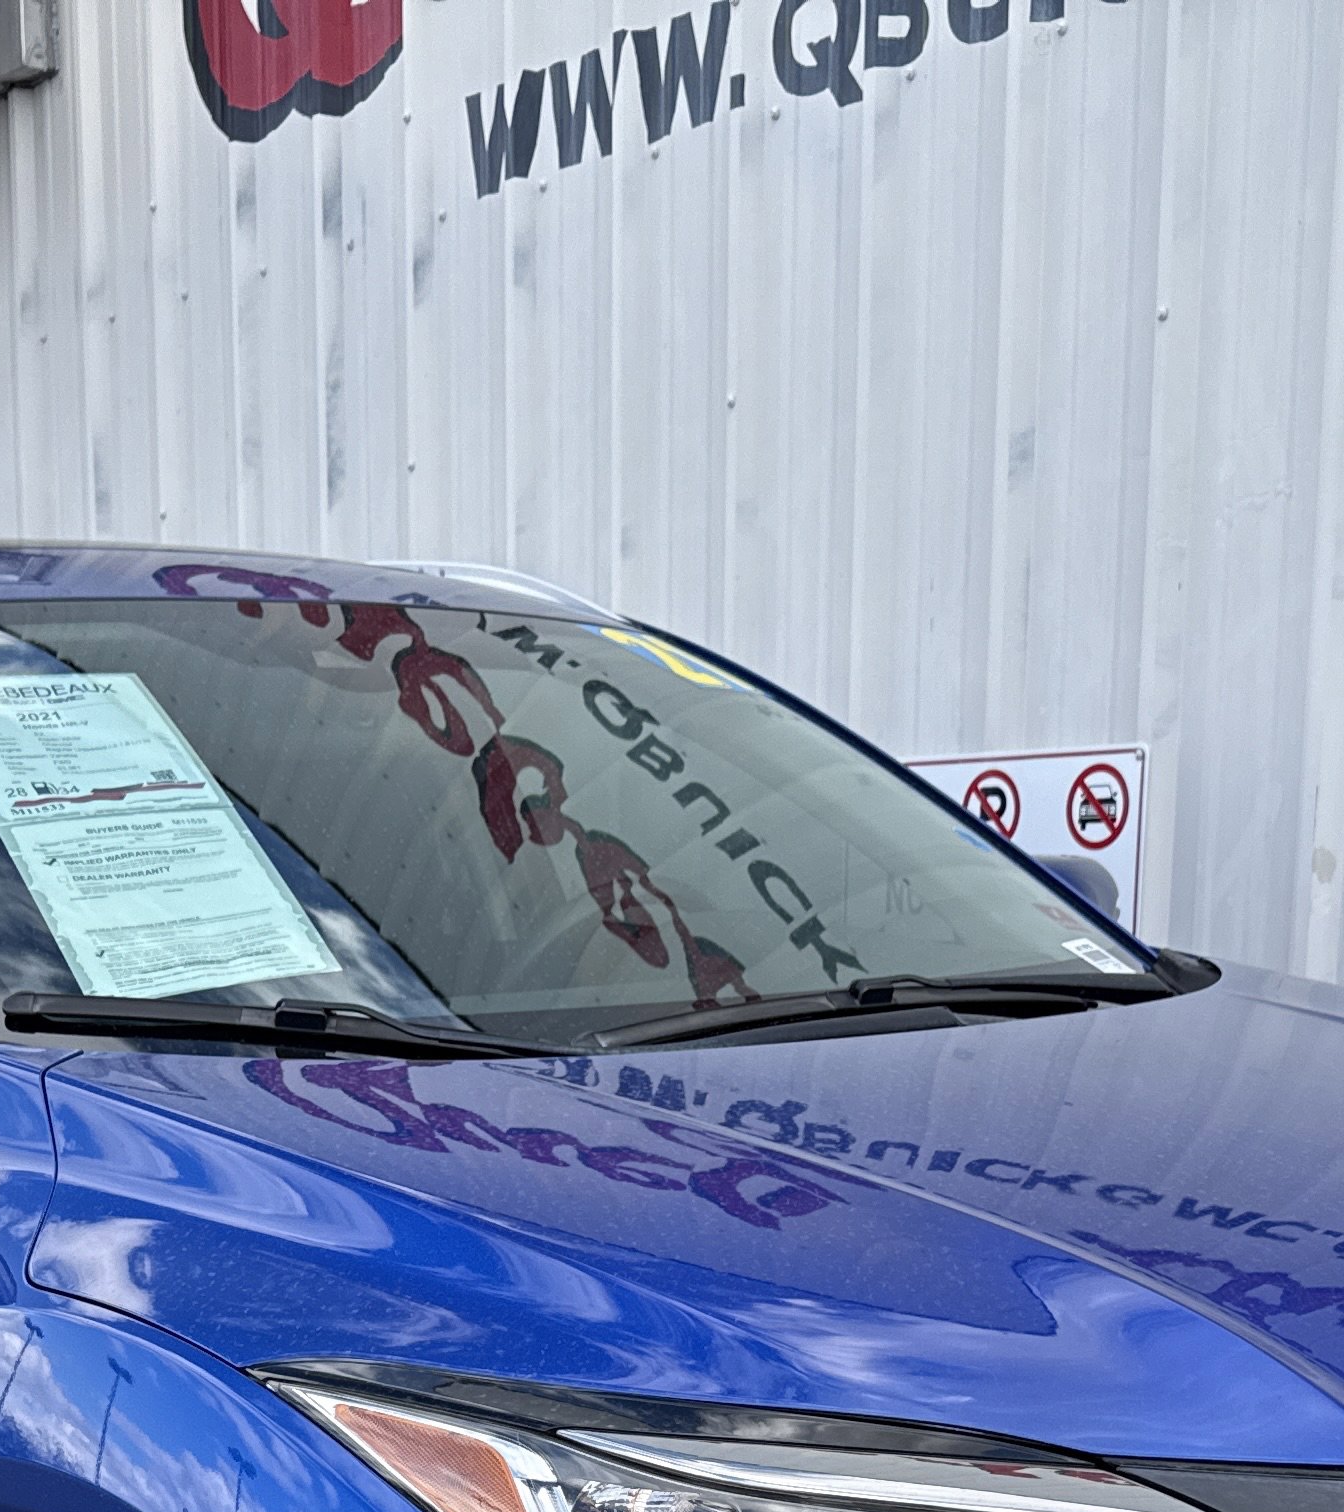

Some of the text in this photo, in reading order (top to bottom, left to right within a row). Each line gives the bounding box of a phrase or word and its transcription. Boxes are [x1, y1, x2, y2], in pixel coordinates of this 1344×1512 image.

[17, 711, 62, 722] 2021
[4, 787, 28, 799] 28
[86, 826, 129, 835] BUYERS
[131, 821, 164, 831] GUIDE
[64, 856, 104, 866] IMPLIED
[105, 848, 170, 863] WARRANTIES
[171, 846, 197, 856] ONLY
[72, 874, 113, 883] DEALER
[114, 865, 171, 881] WARRANTY
